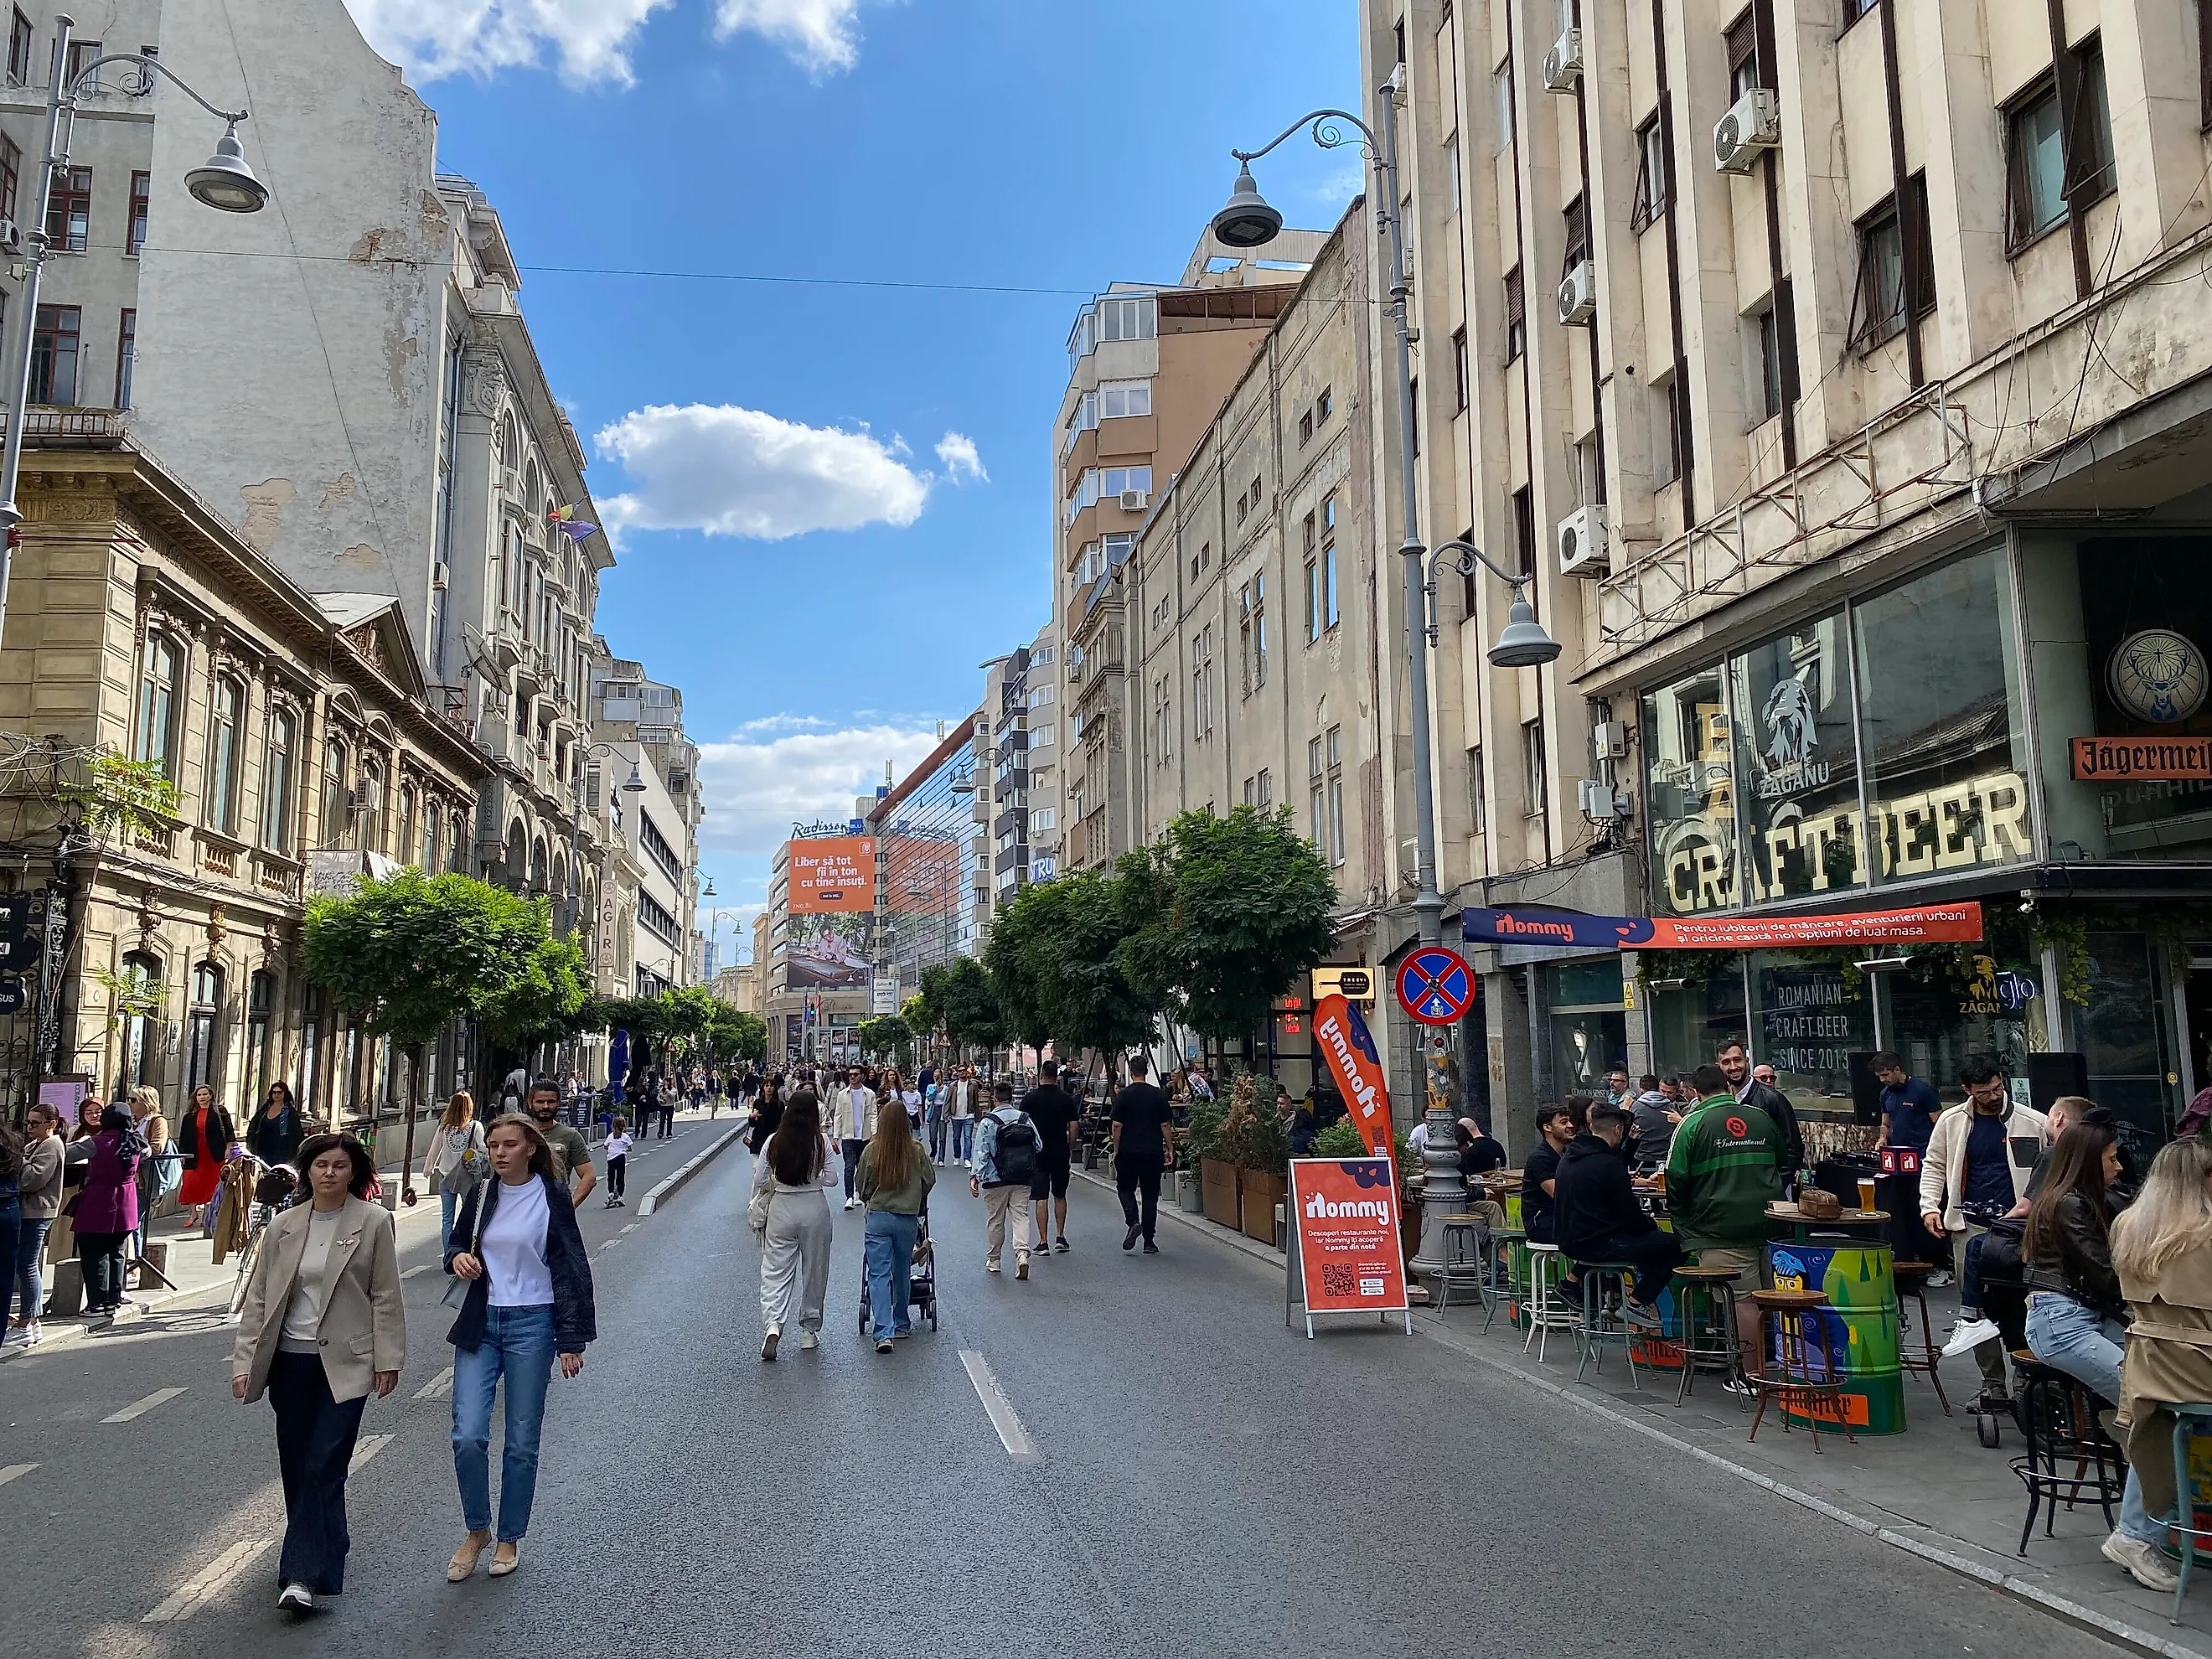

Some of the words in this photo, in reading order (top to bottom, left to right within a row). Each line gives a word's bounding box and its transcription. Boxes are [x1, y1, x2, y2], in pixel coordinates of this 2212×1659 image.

[791, 818, 849, 840] Radisson
[1668, 815, 1836, 912] CRAFT
[1847, 772, 2034, 884] BEER
[794, 856, 819, 866] Liber
[822, 855, 834, 866] să
[836, 855, 851, 866] tot
[816, 866, 826, 876] fii
[830, 866, 838, 876] în
[841, 866, 857, 876] ton
[815, 877, 835, 886] tine
[603, 898, 613, 949] AGIR
[1673, 923, 1716, 933] Pentru
[1718, 923, 1768, 933] iubitorii
[1770, 922, 1786, 931] de
[1789, 919, 1848, 930] mâncare,
[1851, 912, 1924, 926] aventurierii
[1926, 909, 1967, 922] urbani
[1691, 933, 1734, 943] oricine
[1736, 932, 1772, 942] caută
[1774, 931, 1795, 940] noi
[1845, 926, 1860, 938] de
[1863, 926, 1886, 937] luat
[1889, 927, 1927, 937] masa.
[1777, 983, 1842, 1007] ROMANIAN
[2000, 973, 2034, 1010] glo
[1775, 1016, 1812, 1038] CRAFT
[1817, 1016, 1848, 1037] BEER
[1779, 1047, 1815, 1070] SINCE
[1818, 1048, 1849, 1070] 2013
[1718, 1137, 1766, 1148] International
